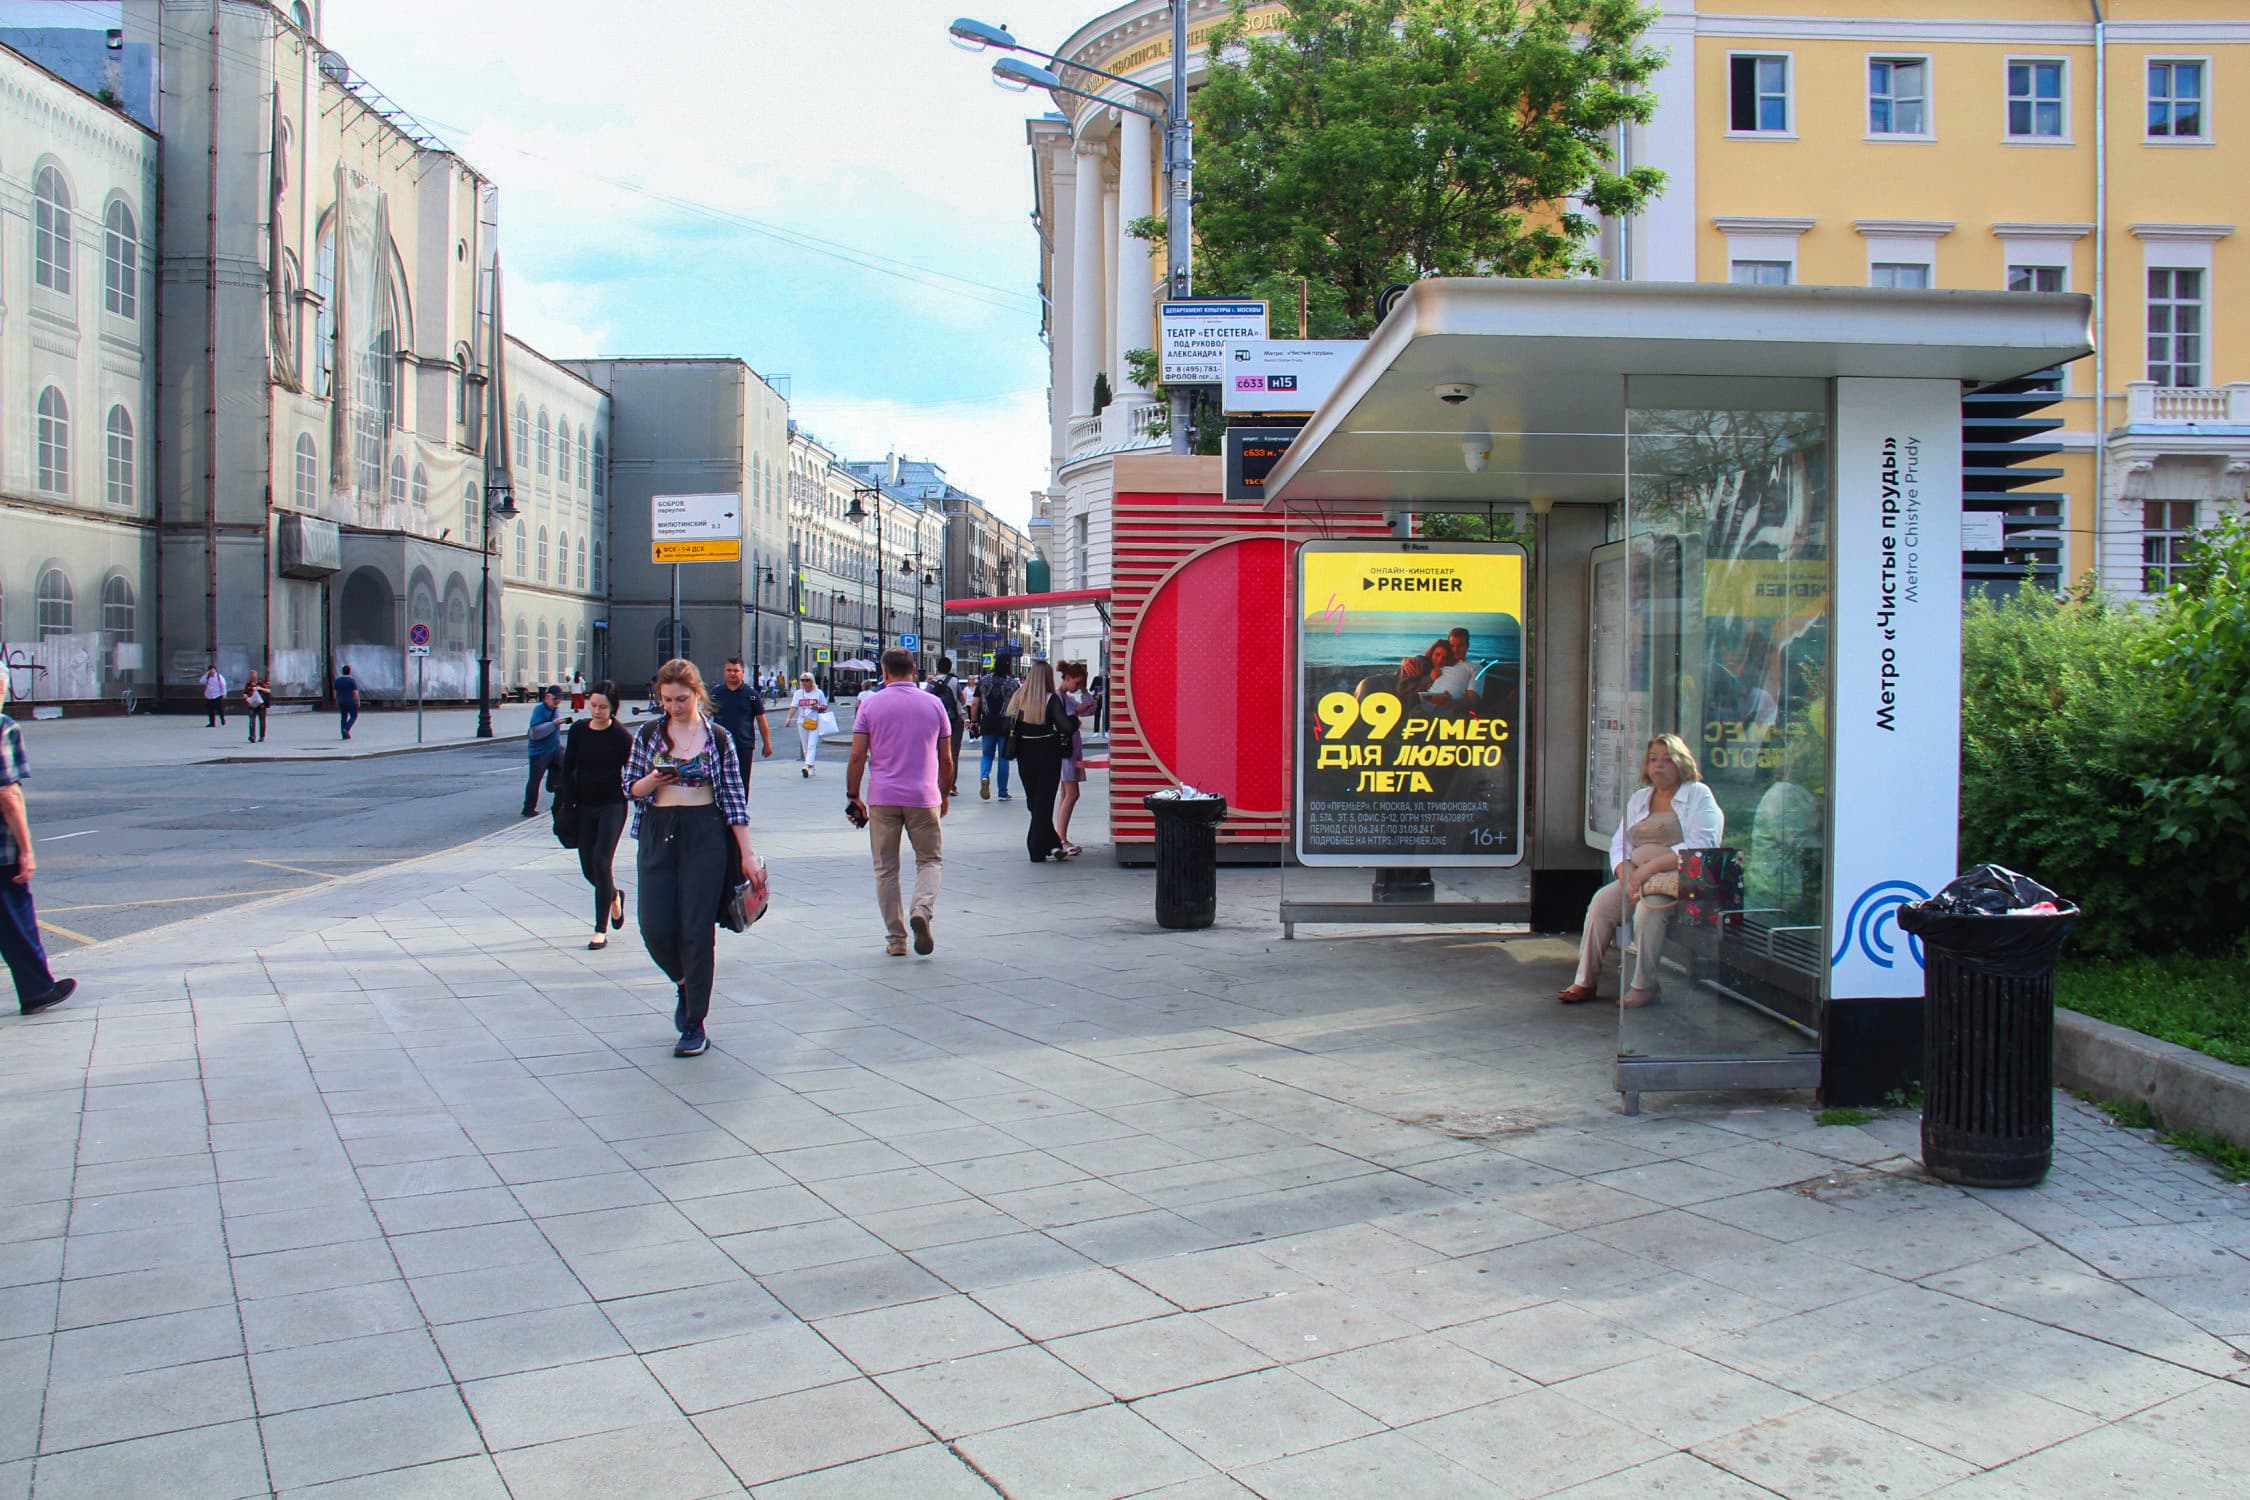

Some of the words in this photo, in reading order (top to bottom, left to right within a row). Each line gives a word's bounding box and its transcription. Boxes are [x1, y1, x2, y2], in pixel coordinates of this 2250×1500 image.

[1167, 328, 1196, 337] ТЕАТР
[1167, 350, 1217, 358] АЛЕКСАНДРА
[1237, 378, 1264, 388] с633
[1904, 437, 1921, 483] Prudy
[1882, 437, 1900, 528] пруды»
[1904, 489, 1921, 548] Chistye
[1370, 566, 1455, 575] ОНЛАЙН-КИНОТЕАТР
[1904, 552, 1918, 603] Metro
[1378, 577, 1462, 592] PREMIER
[1876, 535, 1896, 640] «Чистые
[904, 636, 914, 648] P
[1876, 648, 1900, 732] Метро
[1317, 691, 1402, 739] 99
[1317, 744, 1382, 769] ДЛЯ
[1393, 744, 1502, 767] ЛЮБОГО
[1356, 771, 1434, 793] ЛЕТА
[1310, 801, 1326, 811] ООО
[1357, 812, 1380, 822] ОФИС
[1400, 813, 1419, 823] ОГРН
[1310, 824, 1341, 834] ПЕРИОД
[1348, 824, 1379, 833] 01.06.24
[1387, 824, 1398, 833] ПО
[1399, 824, 1429, 833] 31.08.24
[1469, 828, 1508, 846] 16+
[1309, 835, 1355, 846] ПОДРОБНЕЕ
[1356, 836, 1366, 845] НА
